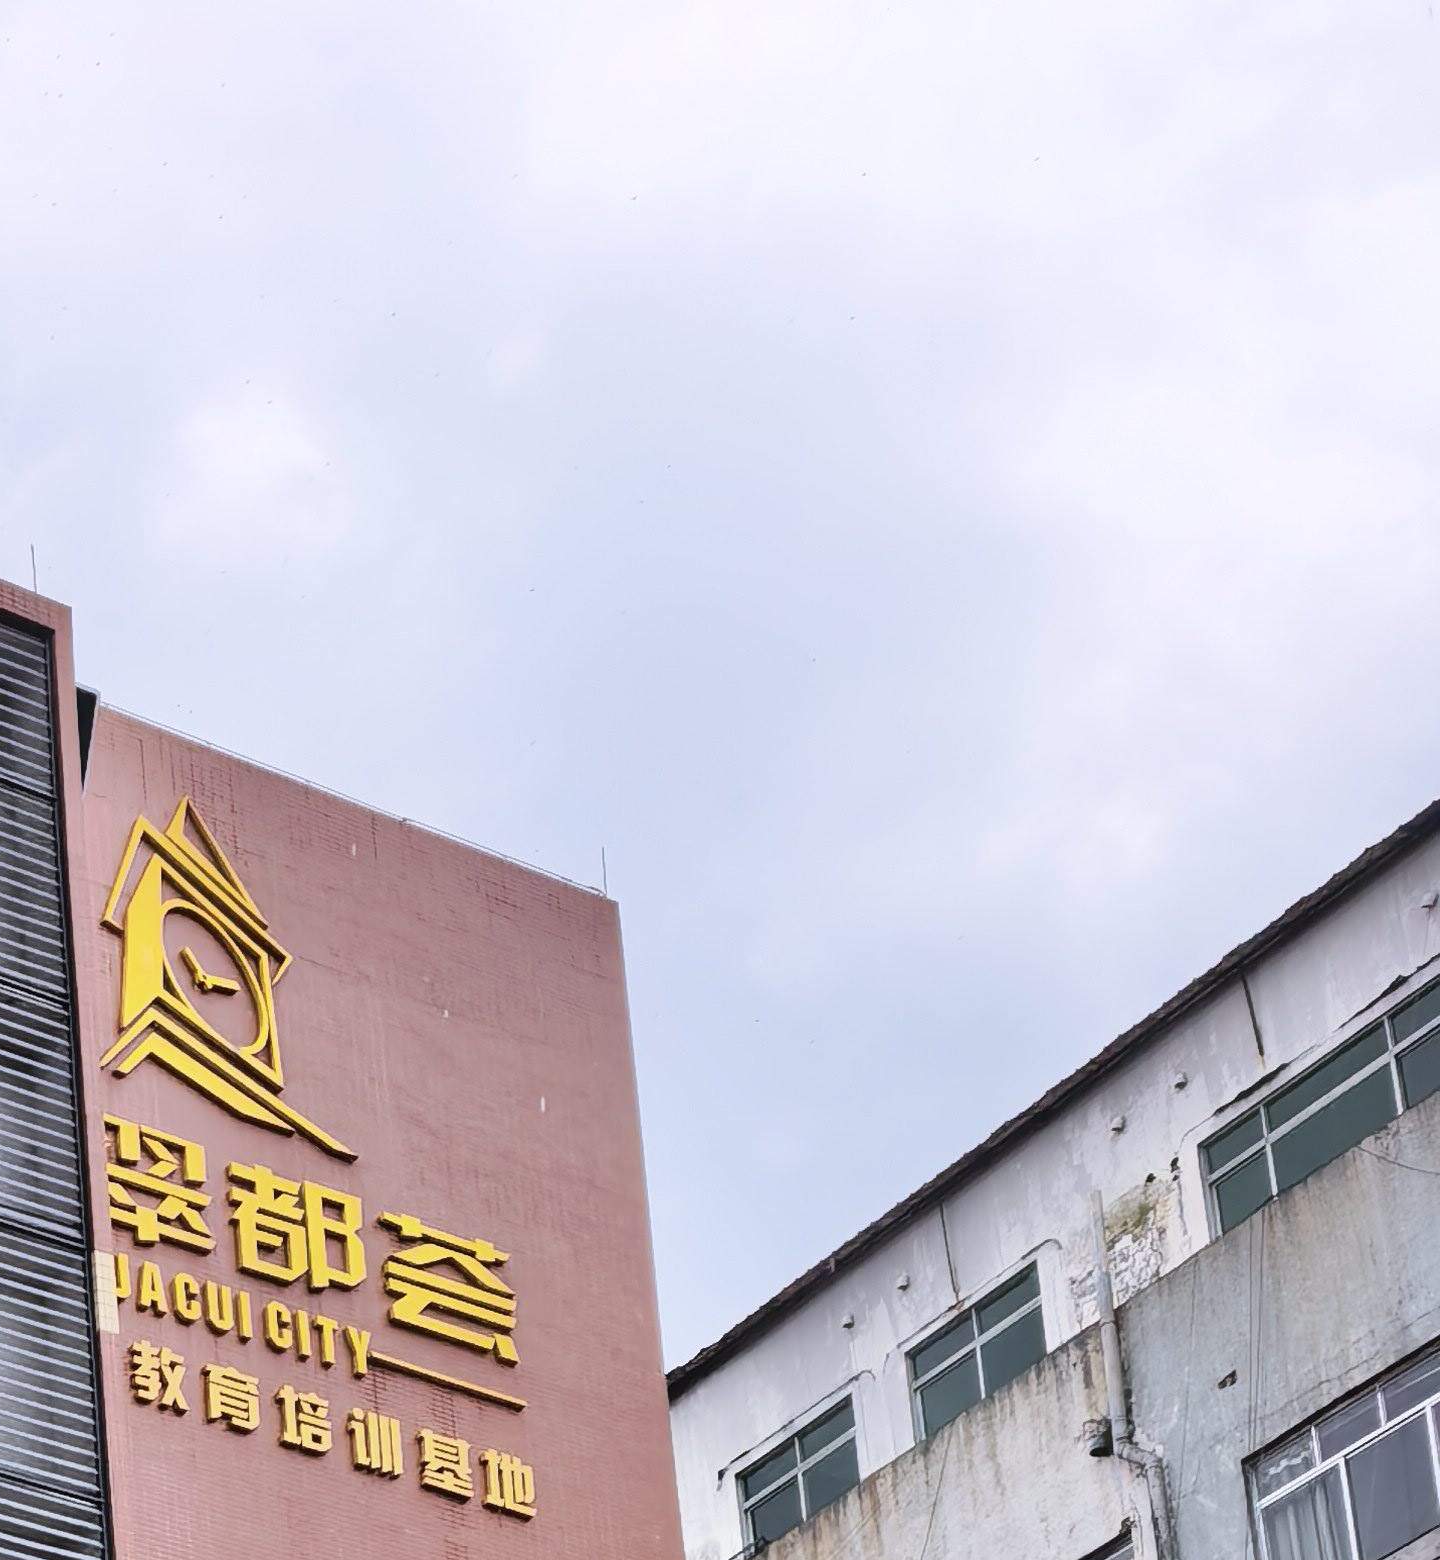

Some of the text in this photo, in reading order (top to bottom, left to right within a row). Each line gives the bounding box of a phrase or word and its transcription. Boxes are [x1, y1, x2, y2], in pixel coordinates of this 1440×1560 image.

[104, 1113, 519, 1366] 翠都荟
[265, 1299, 372, 1378] CITY
[129, 1339, 538, 1521] 教育培训基地
